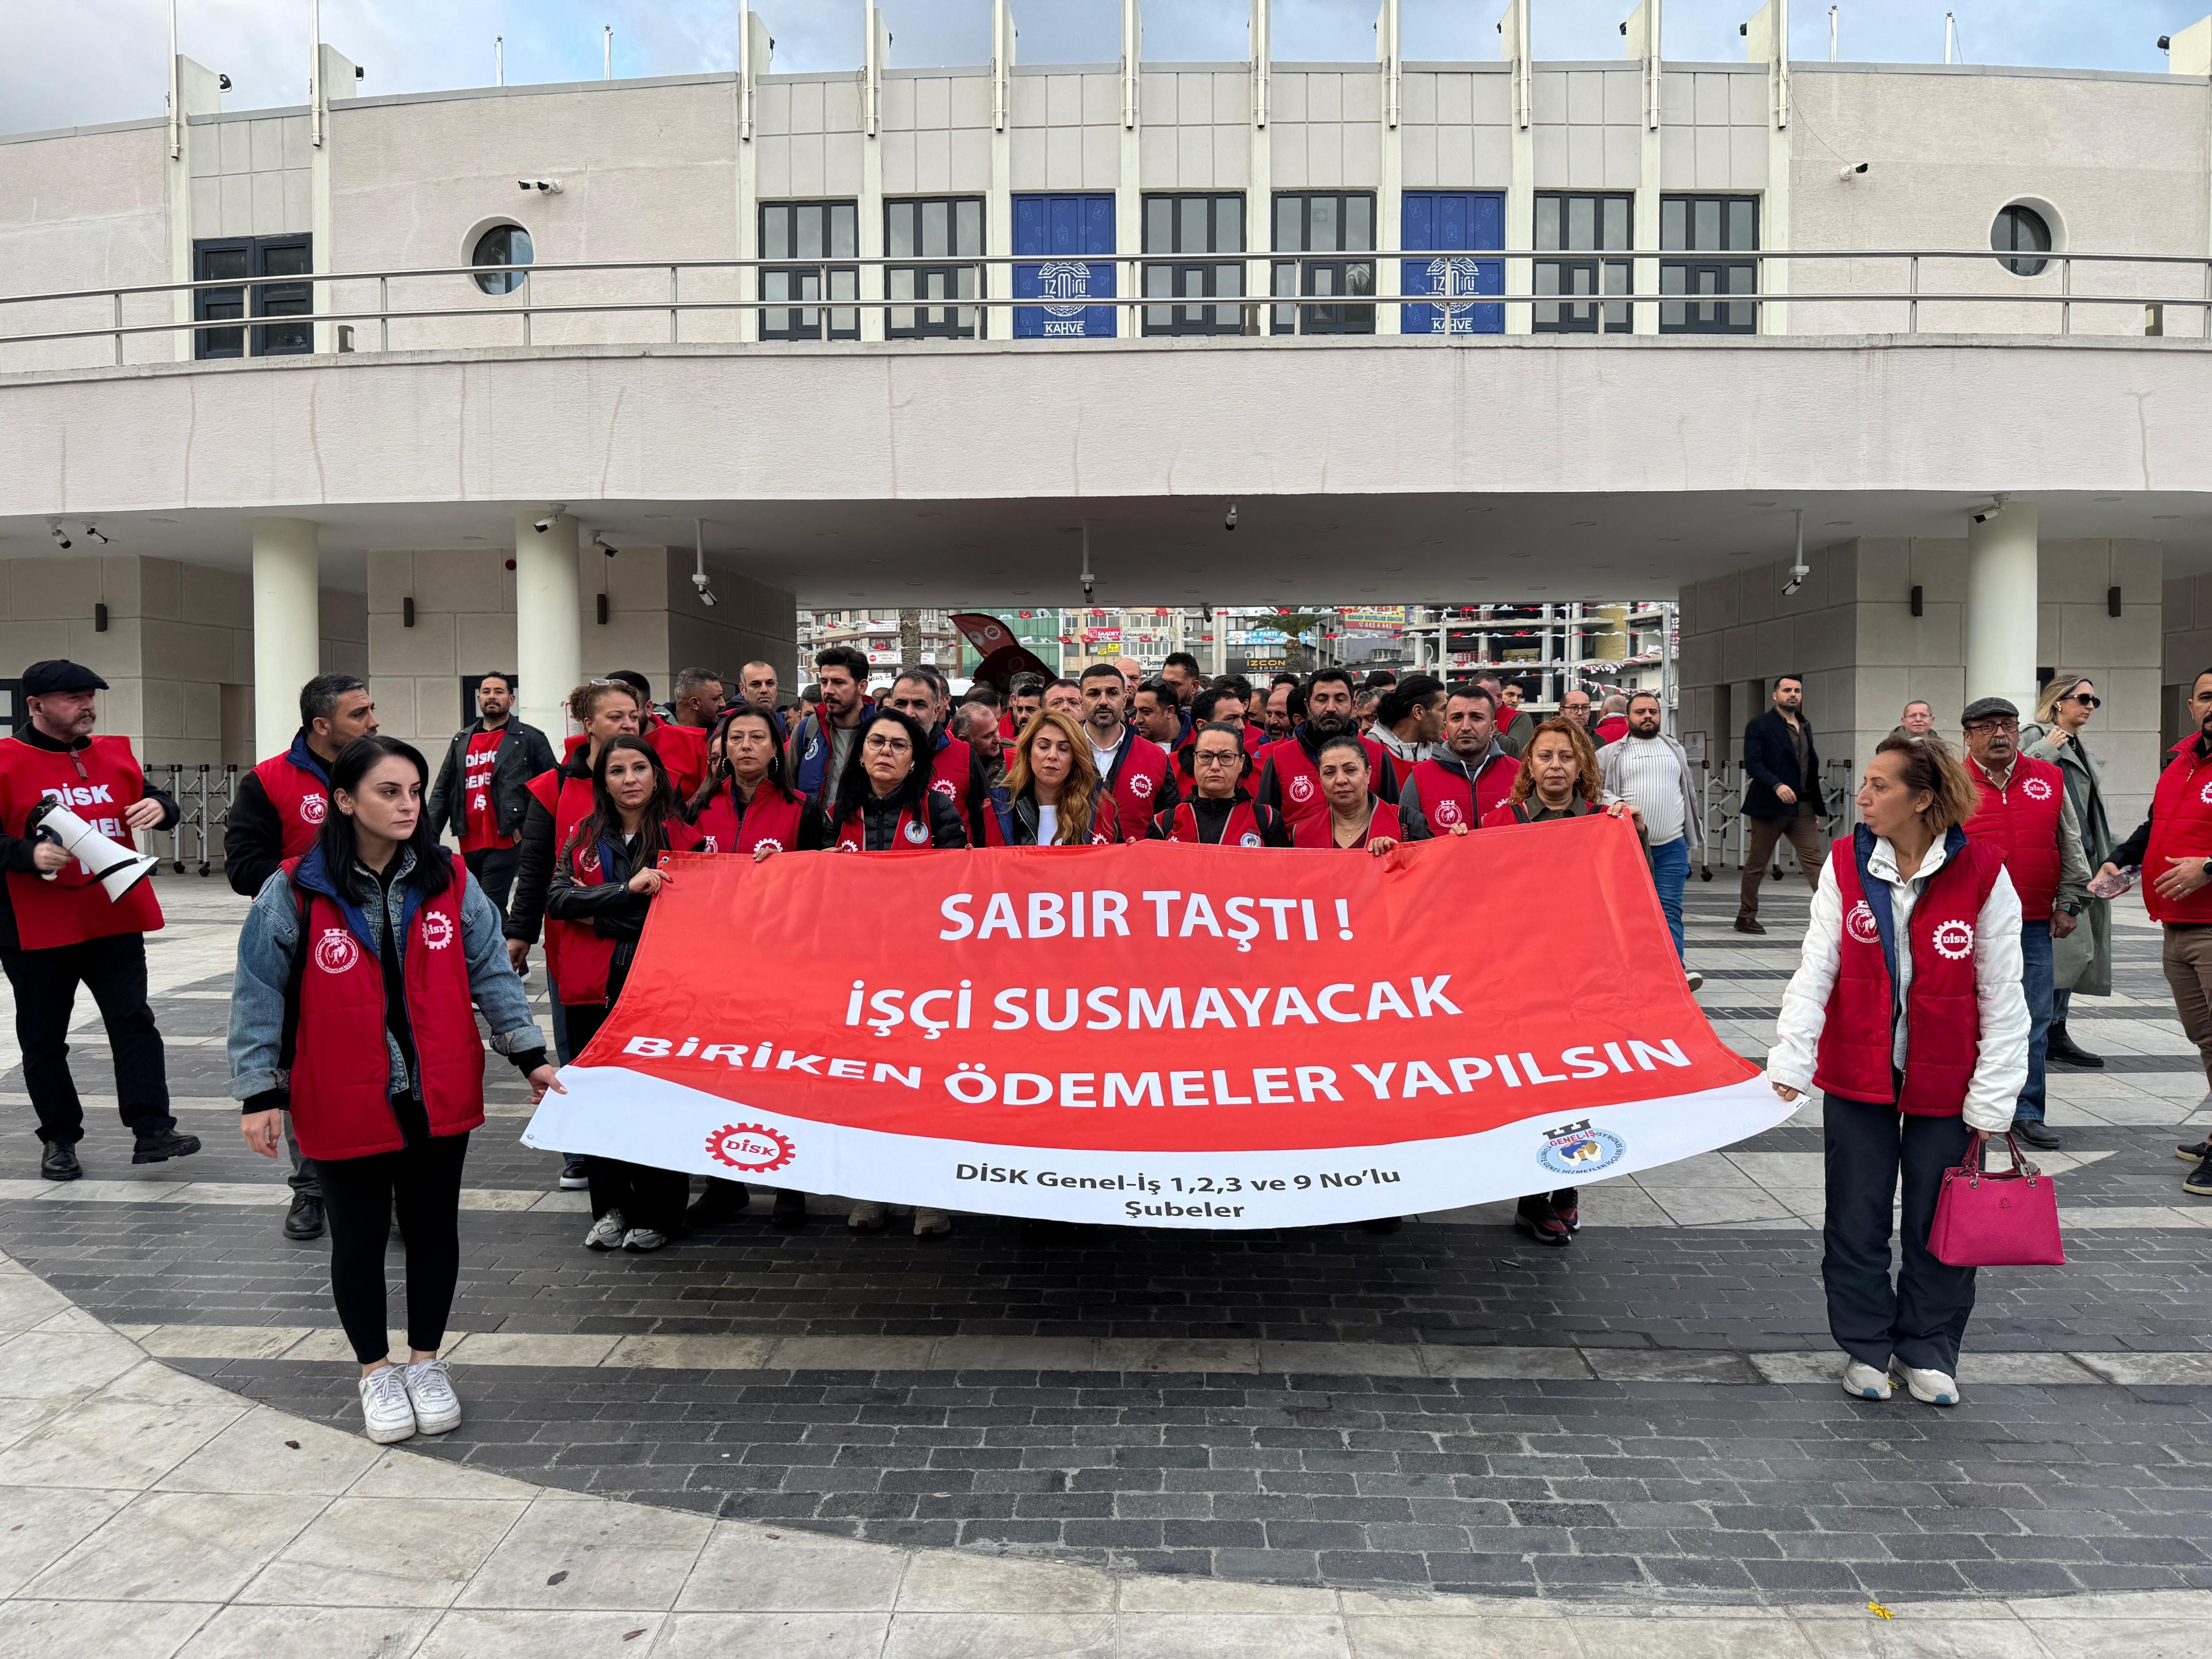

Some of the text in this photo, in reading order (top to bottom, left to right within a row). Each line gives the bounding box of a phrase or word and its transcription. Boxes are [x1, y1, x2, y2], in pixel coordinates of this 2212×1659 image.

[1046, 323, 1084, 335] KAHVE
[465, 750, 497, 767] DİSK
[465, 772, 492, 789] ENE
[1136, 781, 1148, 789] DİSK
[42, 783, 114, 805] DİSK
[474, 793, 486, 811] İŞ
[940, 890, 1353, 952] SABIR TAŞTI !
[1943, 933, 1967, 943] DİSK
[846, 974, 1464, 1039] İŞÇİ SUSMAYACAK
[622, 1036, 1692, 1108] BİRİKEN ÖDEMELER YAPILSIN
[1550, 1130, 1596, 1146] GENEL-İŞ
[725, 1139, 776, 1156] DİSK
[1543, 1161, 1560, 1173] GENEL
[1562, 1164, 1606, 1174] HİZMETLER
[956, 1163, 1028, 1185] DİSK
[1037, 1172, 1161, 1195] Genel-İş
[1171, 1177, 1242, 1194] 1,2,3
[1250, 1180, 1286, 1191] ve
[1293, 1175, 1311, 1189] 9
[1125, 1201, 1244, 1220] Şubeler
